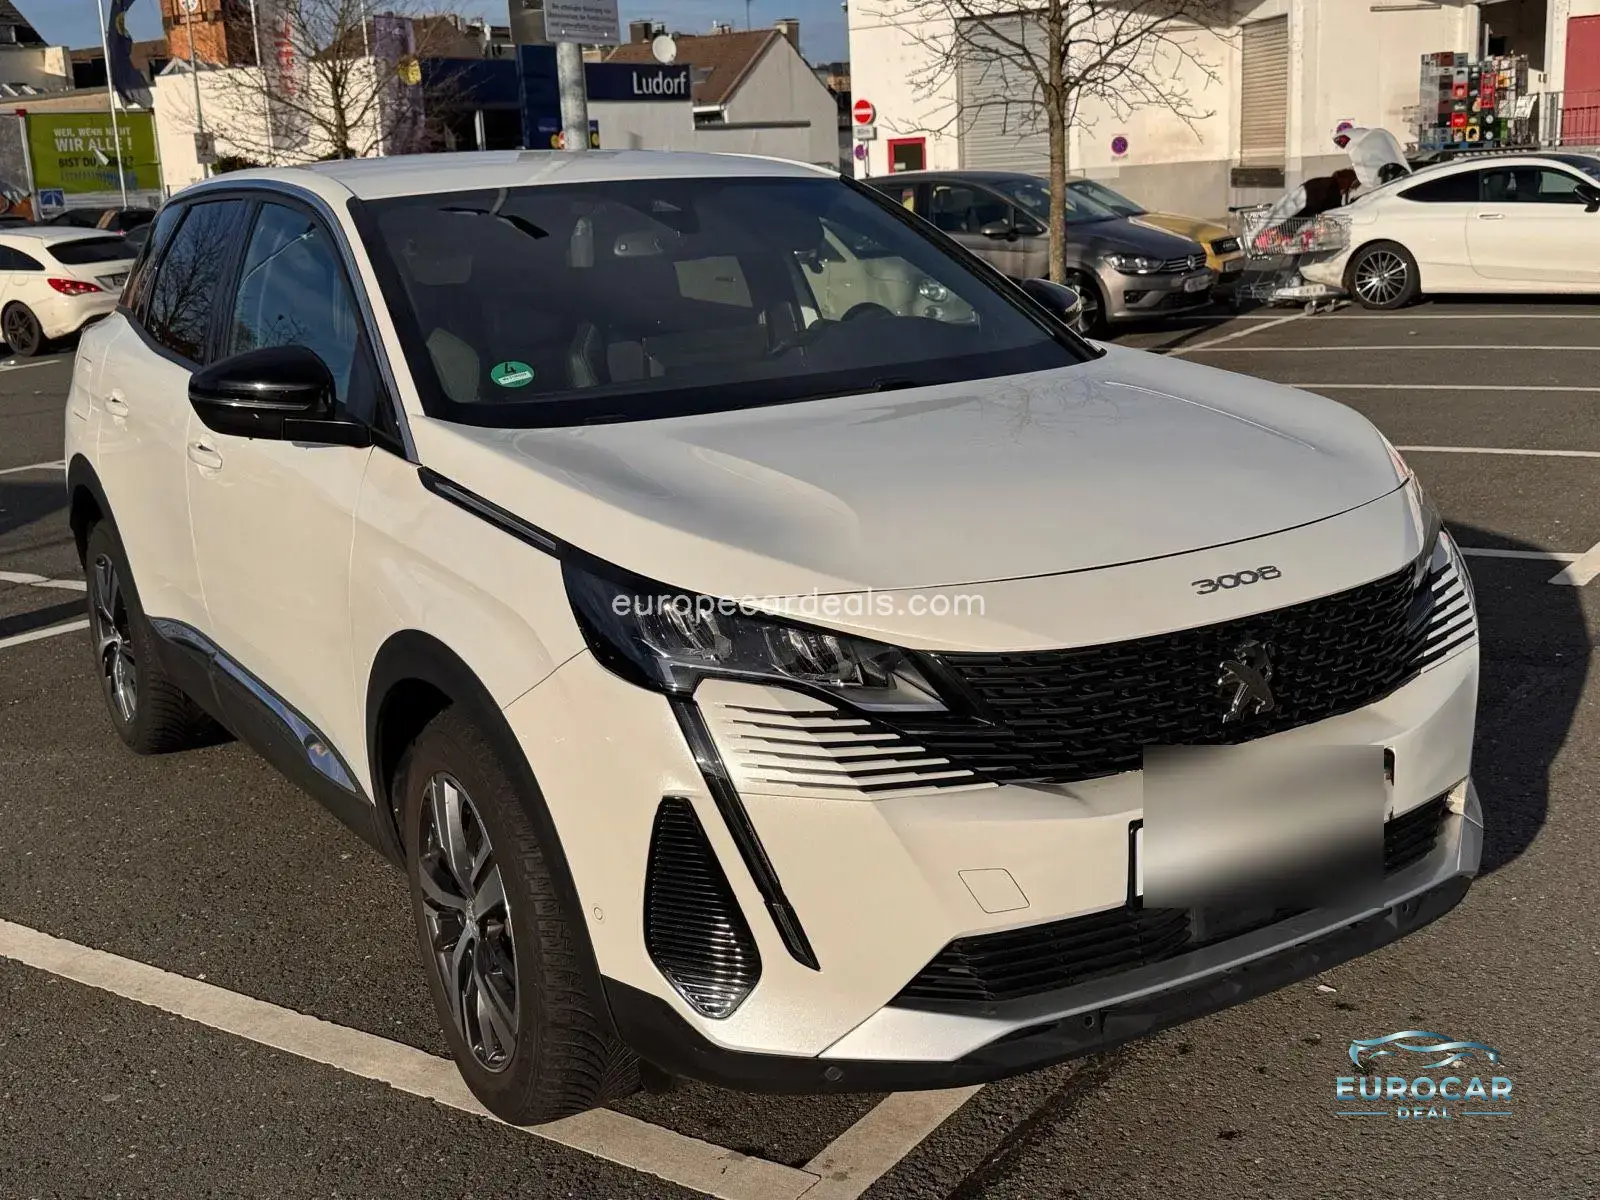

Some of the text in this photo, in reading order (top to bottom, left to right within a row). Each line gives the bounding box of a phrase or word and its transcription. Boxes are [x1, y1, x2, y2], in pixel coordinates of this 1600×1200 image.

[632, 70, 687, 95] Ludorf
[105, 126, 131, 136] NIHT
[54, 138, 84, 152] WIR
[59, 157, 80, 168] BIST
[505, 363, 517, 374] 4
[1191, 565, 1282, 595] 3008
